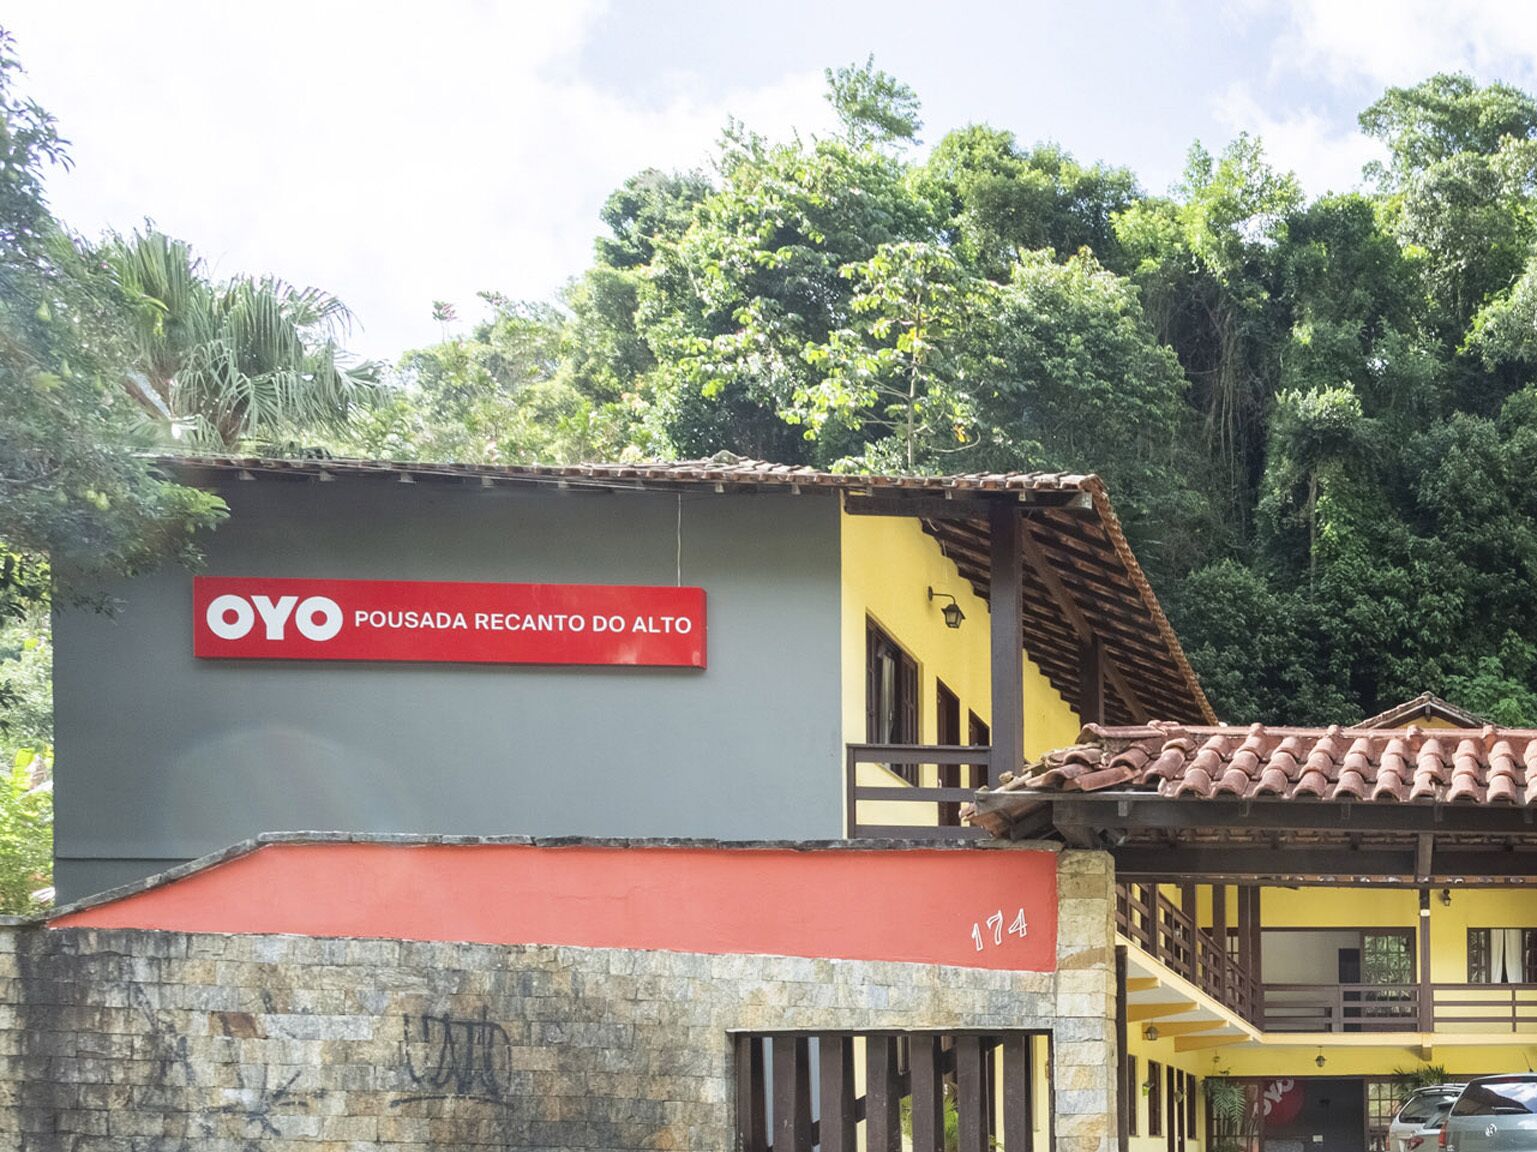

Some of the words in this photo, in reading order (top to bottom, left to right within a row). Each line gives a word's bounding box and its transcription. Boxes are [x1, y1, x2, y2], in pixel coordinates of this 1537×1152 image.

[206, 594, 344, 642] OYO
[355, 610, 468, 630] POUSADA
[475, 613, 585, 632] RECANTO
[593, 615, 625, 633] DO
[632, 616, 692, 635] ALTO
[971, 907, 1028, 952] 174
